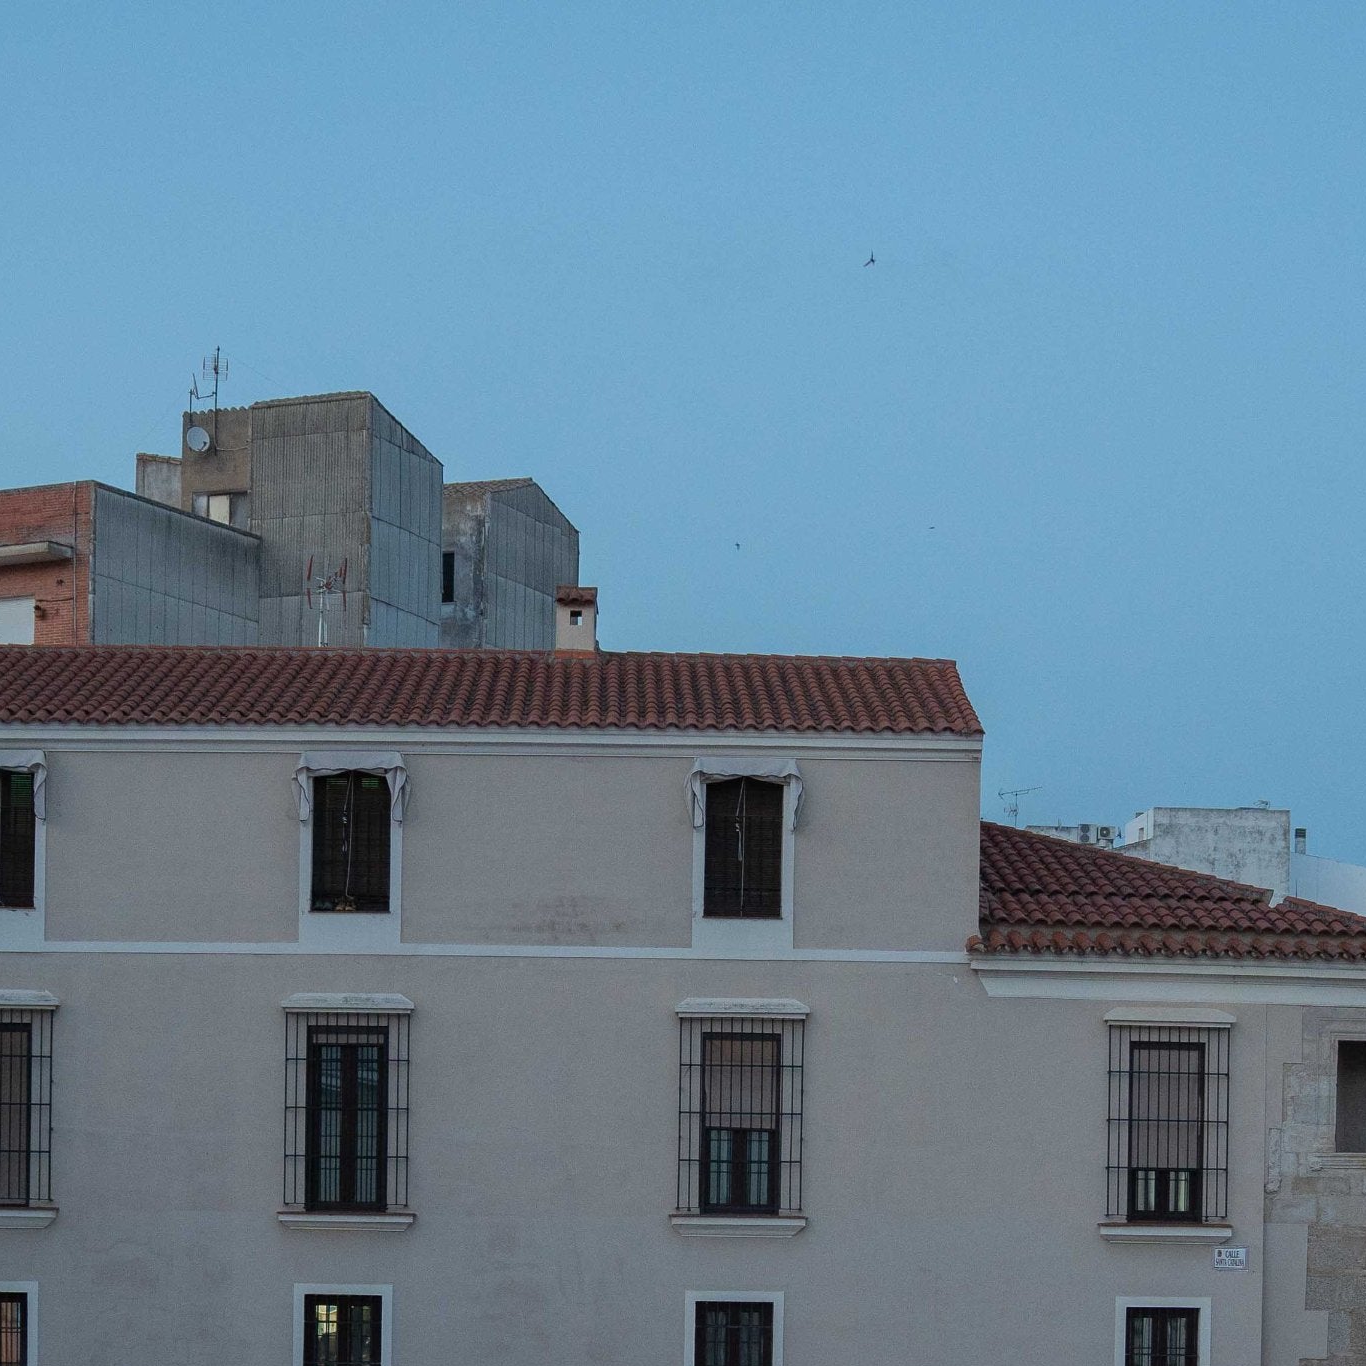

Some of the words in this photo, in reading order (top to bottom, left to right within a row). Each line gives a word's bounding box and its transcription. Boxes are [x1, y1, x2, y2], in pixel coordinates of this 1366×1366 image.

[1225, 1250, 1240, 1258] CALLE
[1215, 1258, 1227, 1266] SANTA
[1228, 1258, 1245, 1266] CATALINA
